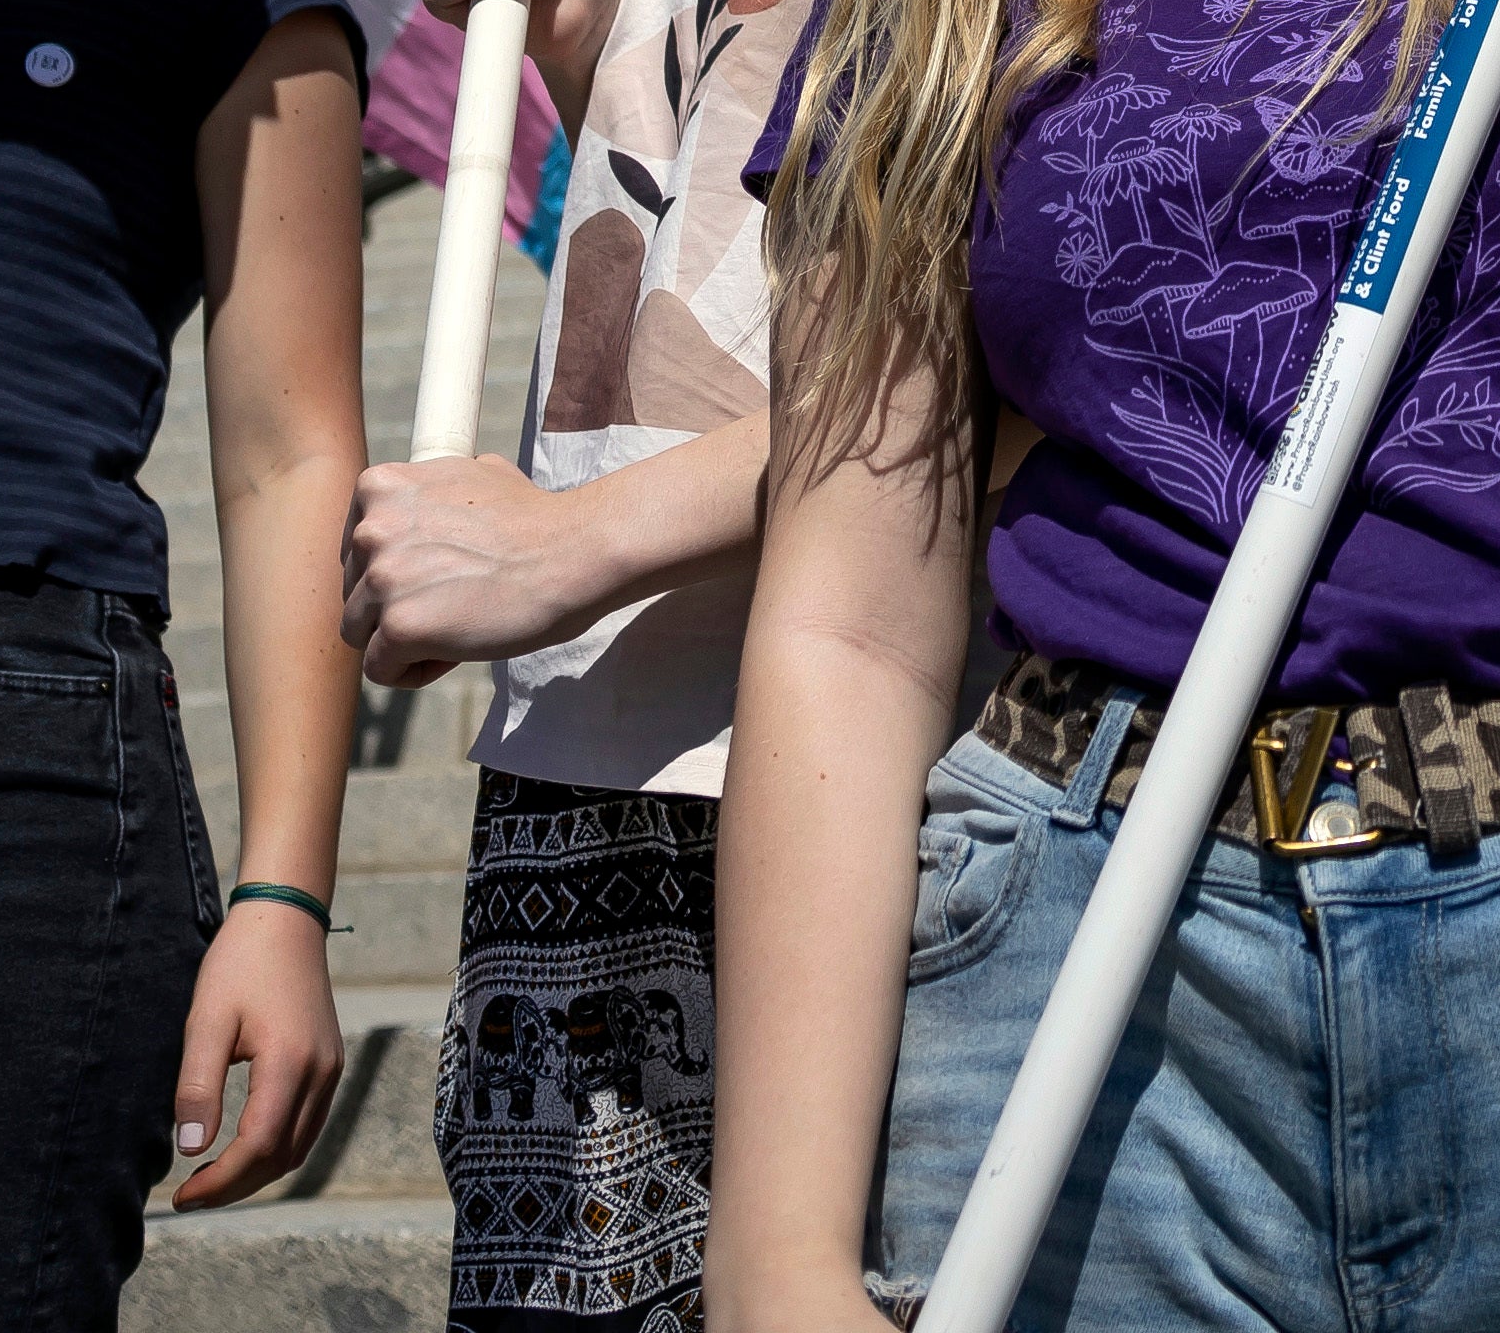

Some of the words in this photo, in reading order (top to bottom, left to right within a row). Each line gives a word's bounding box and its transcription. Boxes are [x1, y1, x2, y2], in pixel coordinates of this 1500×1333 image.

[1414, 71, 1453, 141] Family
[1382, 177, 1411, 224] Ford
[1340, 239, 1369, 295] Bruce
[1362, 227, 1391, 276] Clint
[1355, 280, 1373, 300] &
